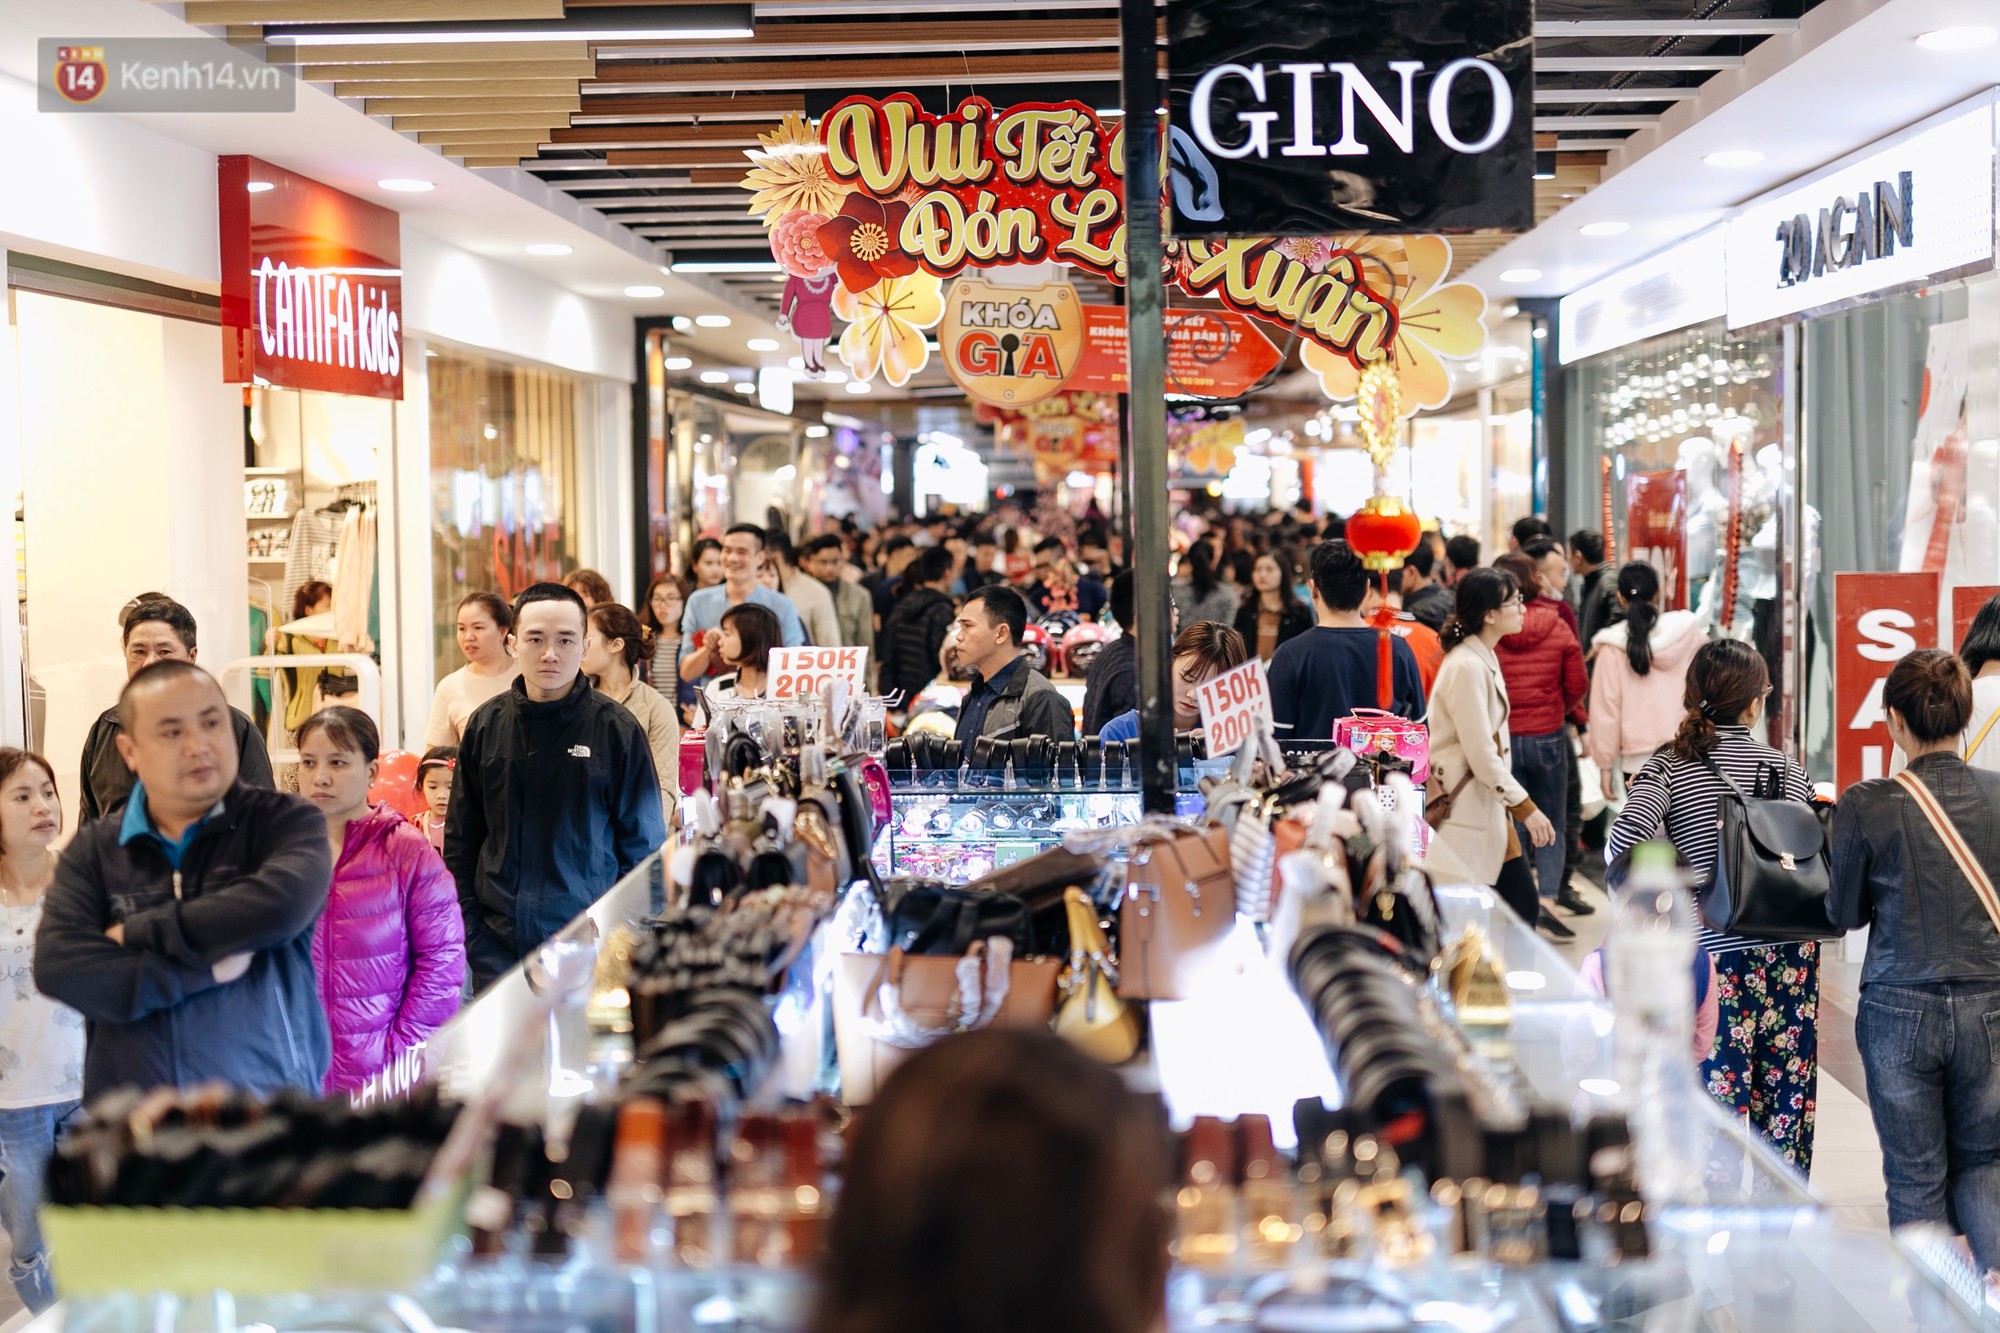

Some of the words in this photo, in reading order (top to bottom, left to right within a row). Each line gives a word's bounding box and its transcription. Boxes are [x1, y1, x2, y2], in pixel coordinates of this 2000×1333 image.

[827, 101, 993, 194] Vui
[994, 108, 1098, 187] Tết
[1189, 57, 1514, 160] GINO
[899, 190, 1045, 268] Đón
[357, 283, 401, 378] kids
[960, 296, 1061, 330] KHÓA
[1188, 238, 1392, 362] Xuân
[780, 649, 858, 670] 150K
[1202, 663, 1262, 718] 150K
[1211, 701, 1263, 753] 200
